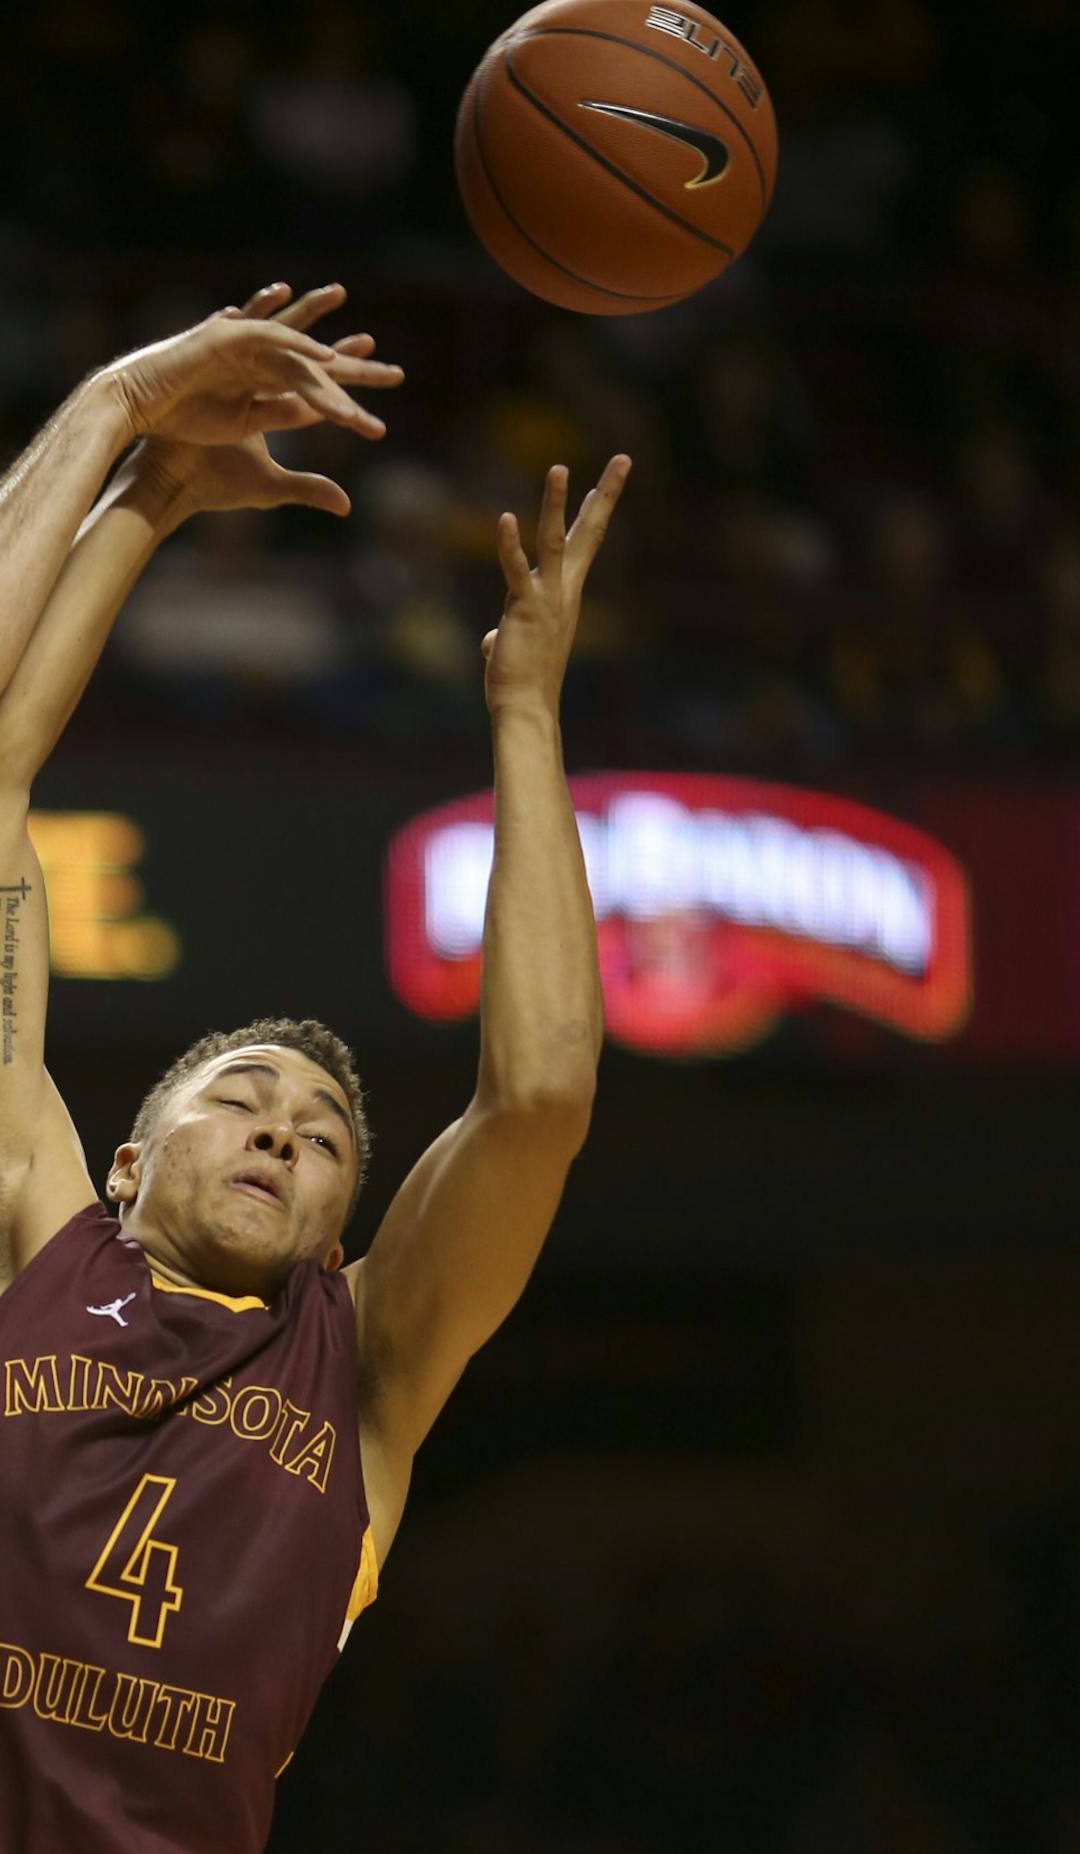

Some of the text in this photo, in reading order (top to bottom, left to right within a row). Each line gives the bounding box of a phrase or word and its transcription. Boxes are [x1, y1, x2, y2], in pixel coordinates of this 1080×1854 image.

[5, 919, 20, 942] Lord
[7, 897, 19, 914] The
[4, 1354, 336, 1493] MINNSOTA
[85, 1473, 183, 1648] 4
